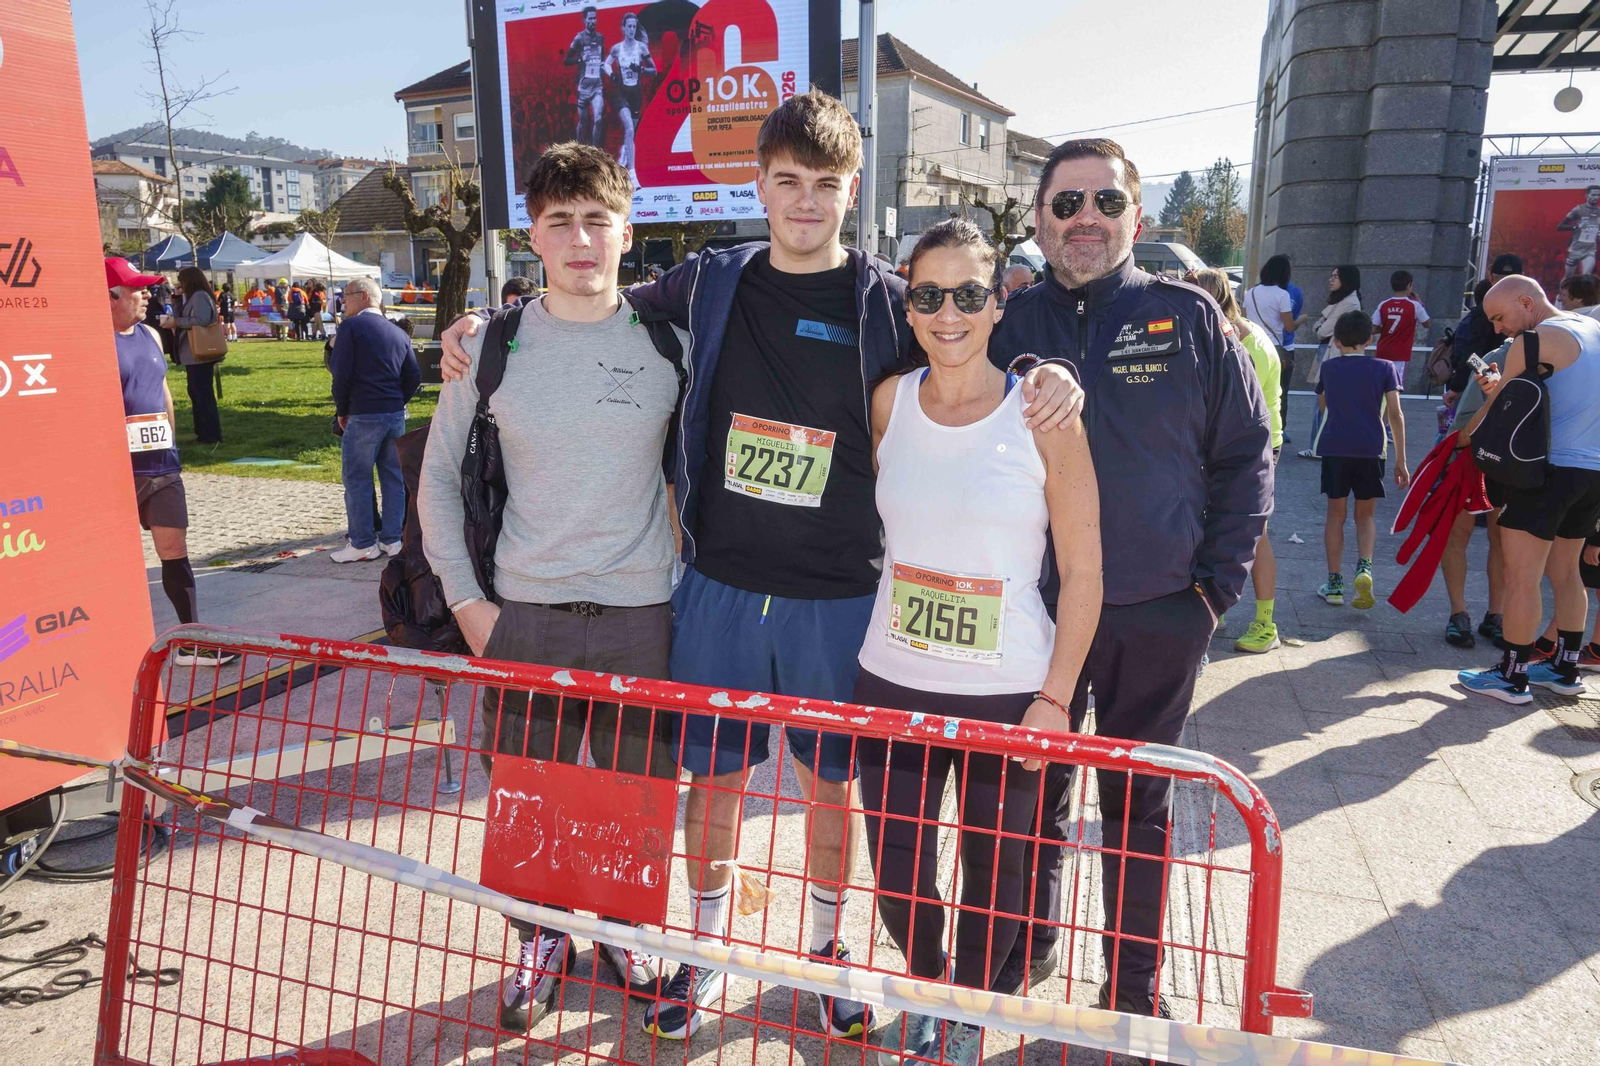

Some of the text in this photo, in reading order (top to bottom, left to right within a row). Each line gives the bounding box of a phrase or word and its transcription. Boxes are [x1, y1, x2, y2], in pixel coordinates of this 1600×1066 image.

[707, 114, 768, 124] CIRCUITO HOMOLOGADO
[693, 191, 718, 201] GADIS
[0, 297, 48, 309] ARE 2B
[1387, 315, 1401, 334] 7
[1112, 365, 1128, 374] MIGUEL
[1130, 364, 1144, 373] ANGEL
[1145, 363, 1162, 372] BLANCO
[140, 425, 167, 443] 662
[756, 437, 800, 452] MIGUELITO
[738, 443, 815, 490] 2237
[920, 588, 966, 604] RAQUELITA
[35, 606, 90, 634] GIA
[906, 596, 978, 645] 2156
